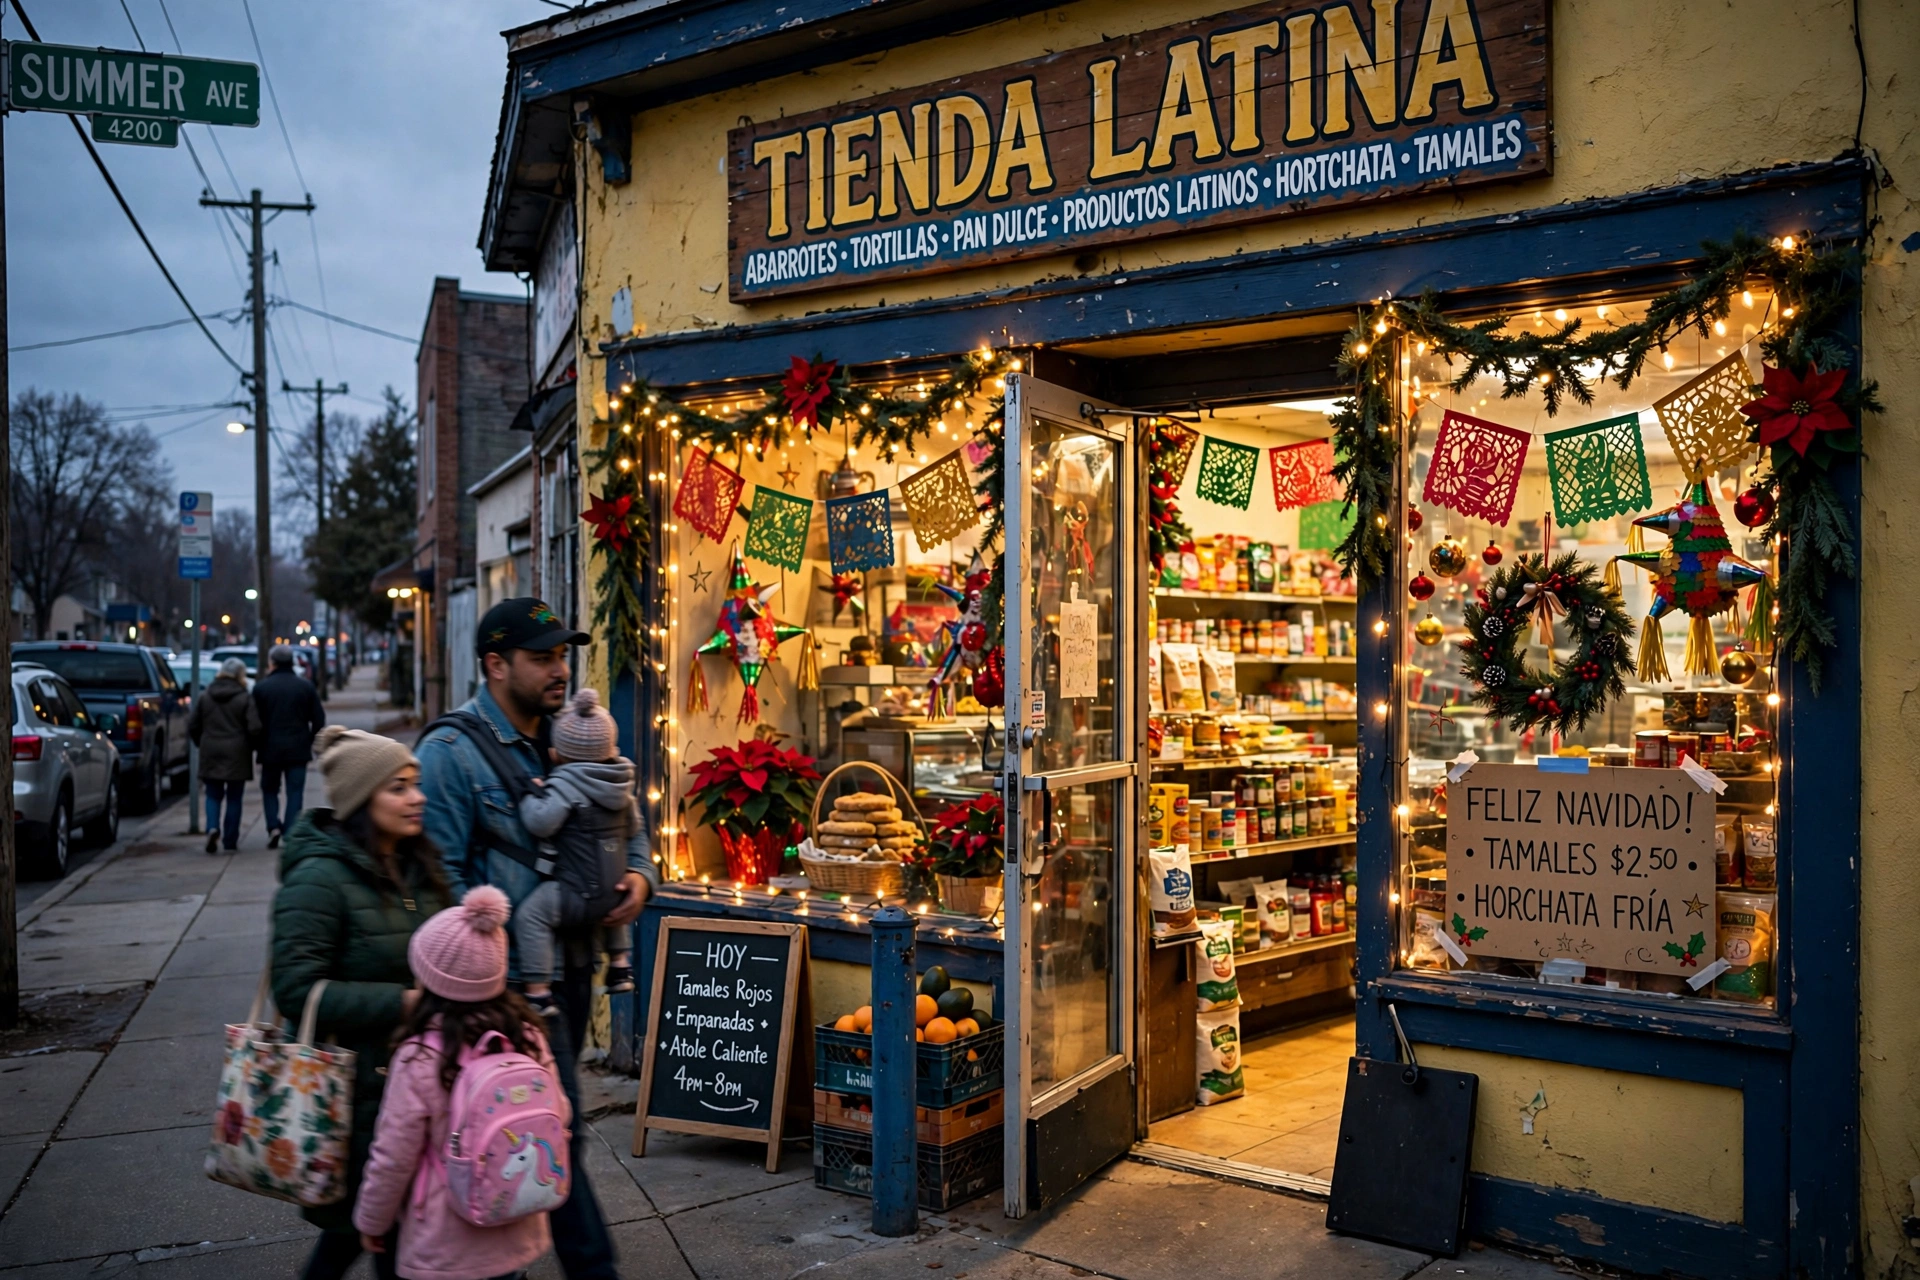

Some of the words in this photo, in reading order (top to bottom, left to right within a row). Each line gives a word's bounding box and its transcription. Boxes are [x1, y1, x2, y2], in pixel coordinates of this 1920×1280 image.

[20, 52, 186, 112] SUMMER
[205, 80, 249, 110] AVE
[108, 118, 163, 142] 4200
[752, 78, 1055, 239] TIENDA
[1088, 0, 1495, 181] LATINA
[745, 240, 838, 286] ABARROTES
[850, 223, 938, 269] TORTILLAS
[953, 215, 987, 252] PAN
[992, 204, 1047, 244] DULCE
[1063, 183, 1170, 234] PRODUCTOS
[1176, 167, 1258, 214] LATINOS
[1276, 142, 1397, 199] HORTCHATA
[1413, 119, 1522, 174] TAMALES
[1466, 786, 1542, 824] FELIZ
[1556, 790, 1694, 834] NAVIDAD!
[1483, 836, 1598, 876] TAMALES
[1610, 844, 1677, 879] $2.50
[1474, 883, 1600, 928] HORCHATA
[1613, 888, 1674, 935] FRÍA
[705, 941, 748, 972] HOY
[675, 974, 730, 999] Tamales
[735, 978, 773, 1008] Rojos
[676, 1005, 755, 1034] Empanadas
[668, 1034, 707, 1059] Atole
[712, 1038, 768, 1065] Caliente
